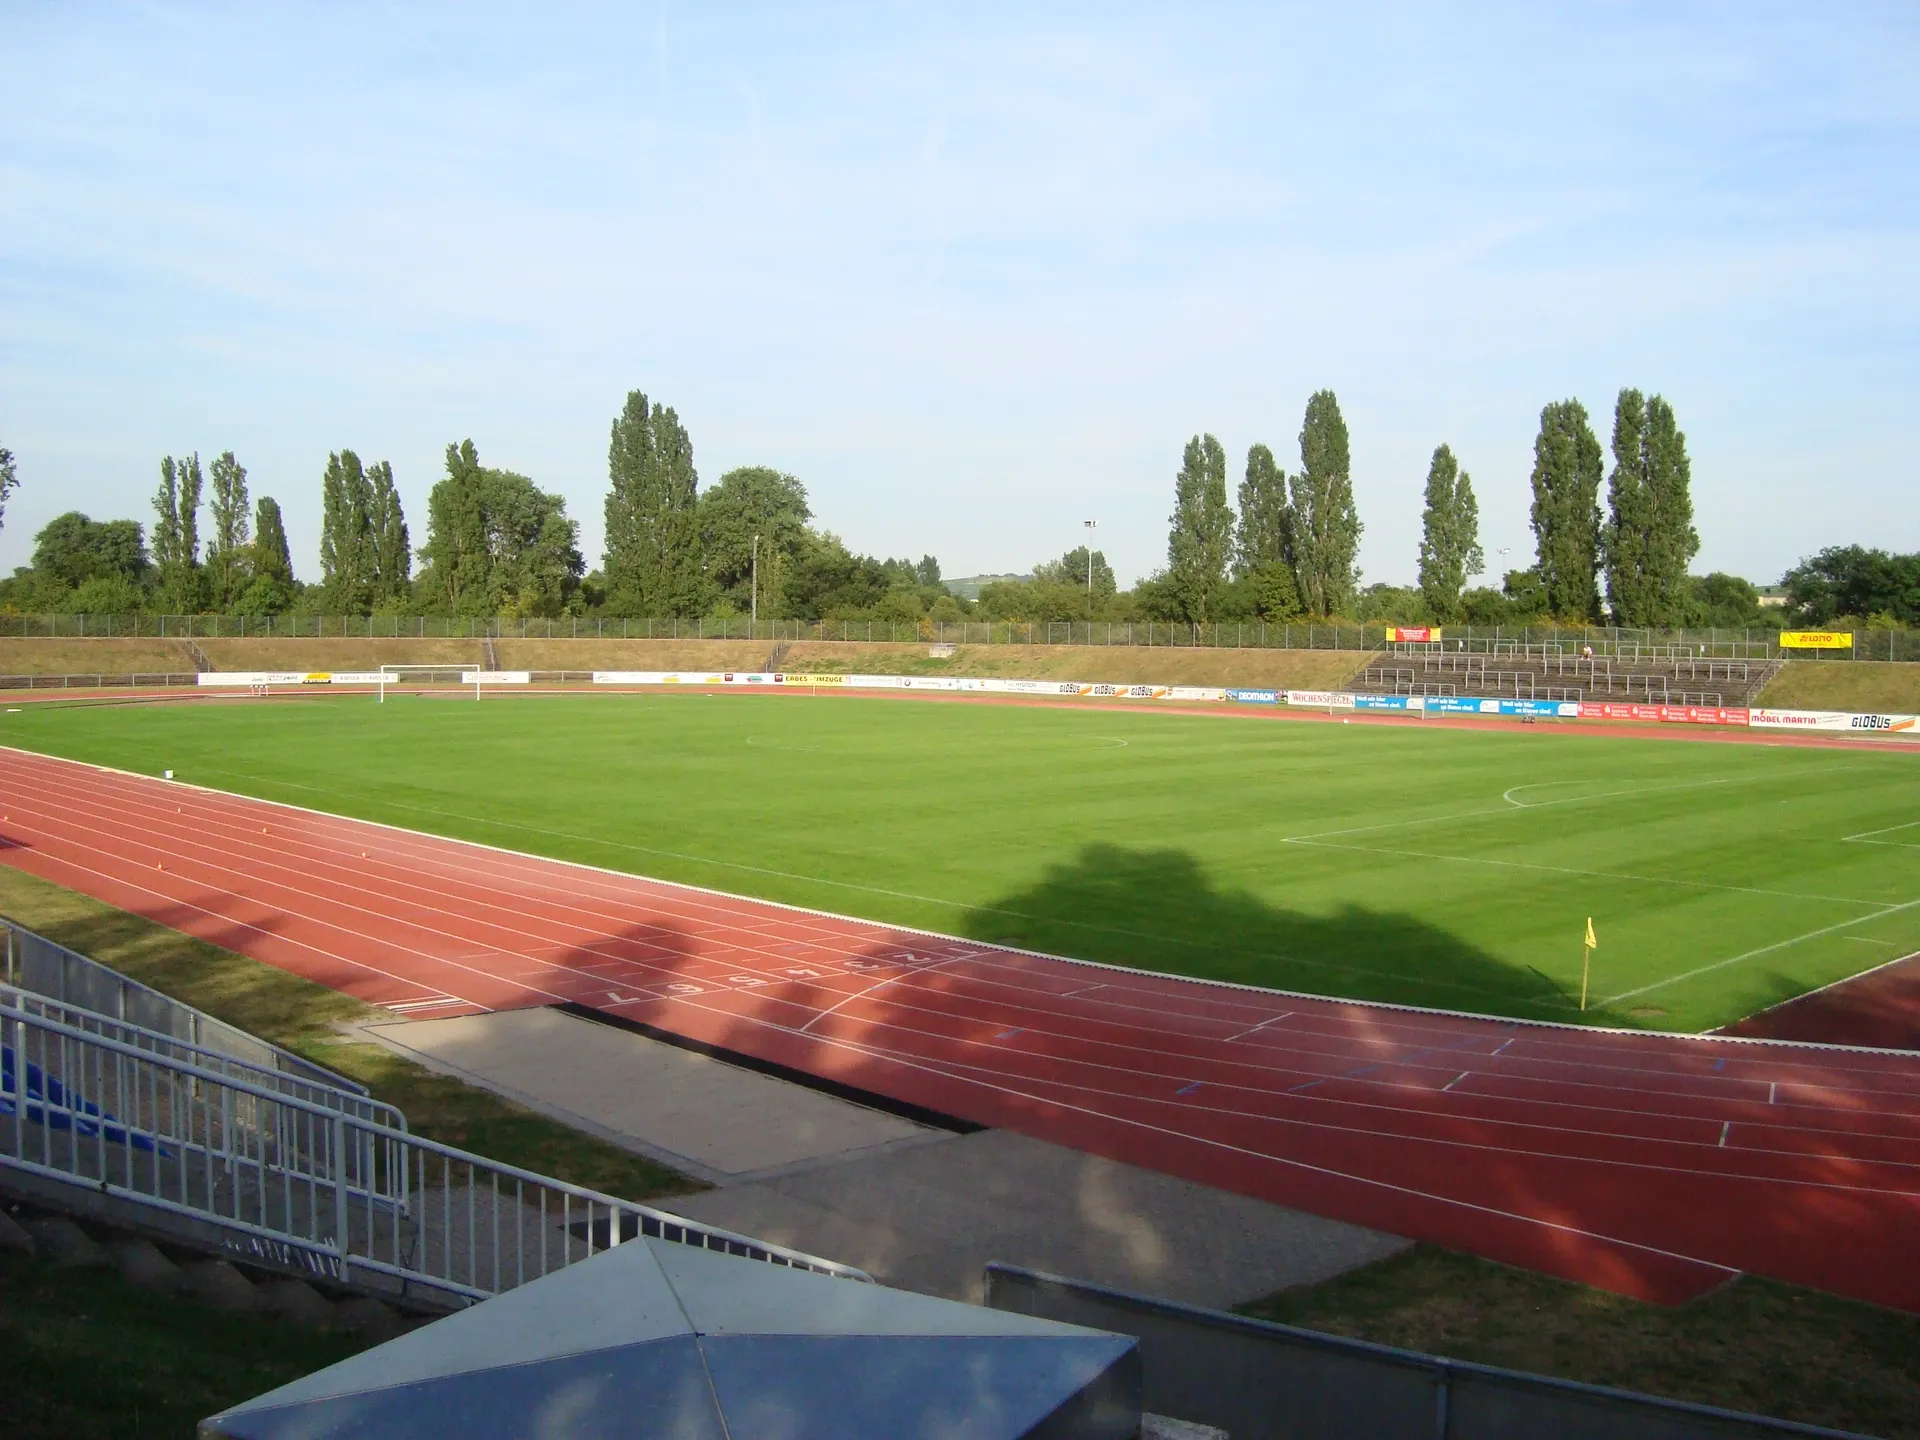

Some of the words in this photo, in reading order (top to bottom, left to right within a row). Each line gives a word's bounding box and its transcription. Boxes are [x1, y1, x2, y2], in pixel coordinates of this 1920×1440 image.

[1059, 683, 1081, 694] GLOBUS
[1094, 684, 1116, 695] GLOBUS
[1131, 686, 1153, 697] GLOBUS
[1782, 715, 1817, 725] MARTIN
[1851, 715, 1891, 729] GLOBUS
